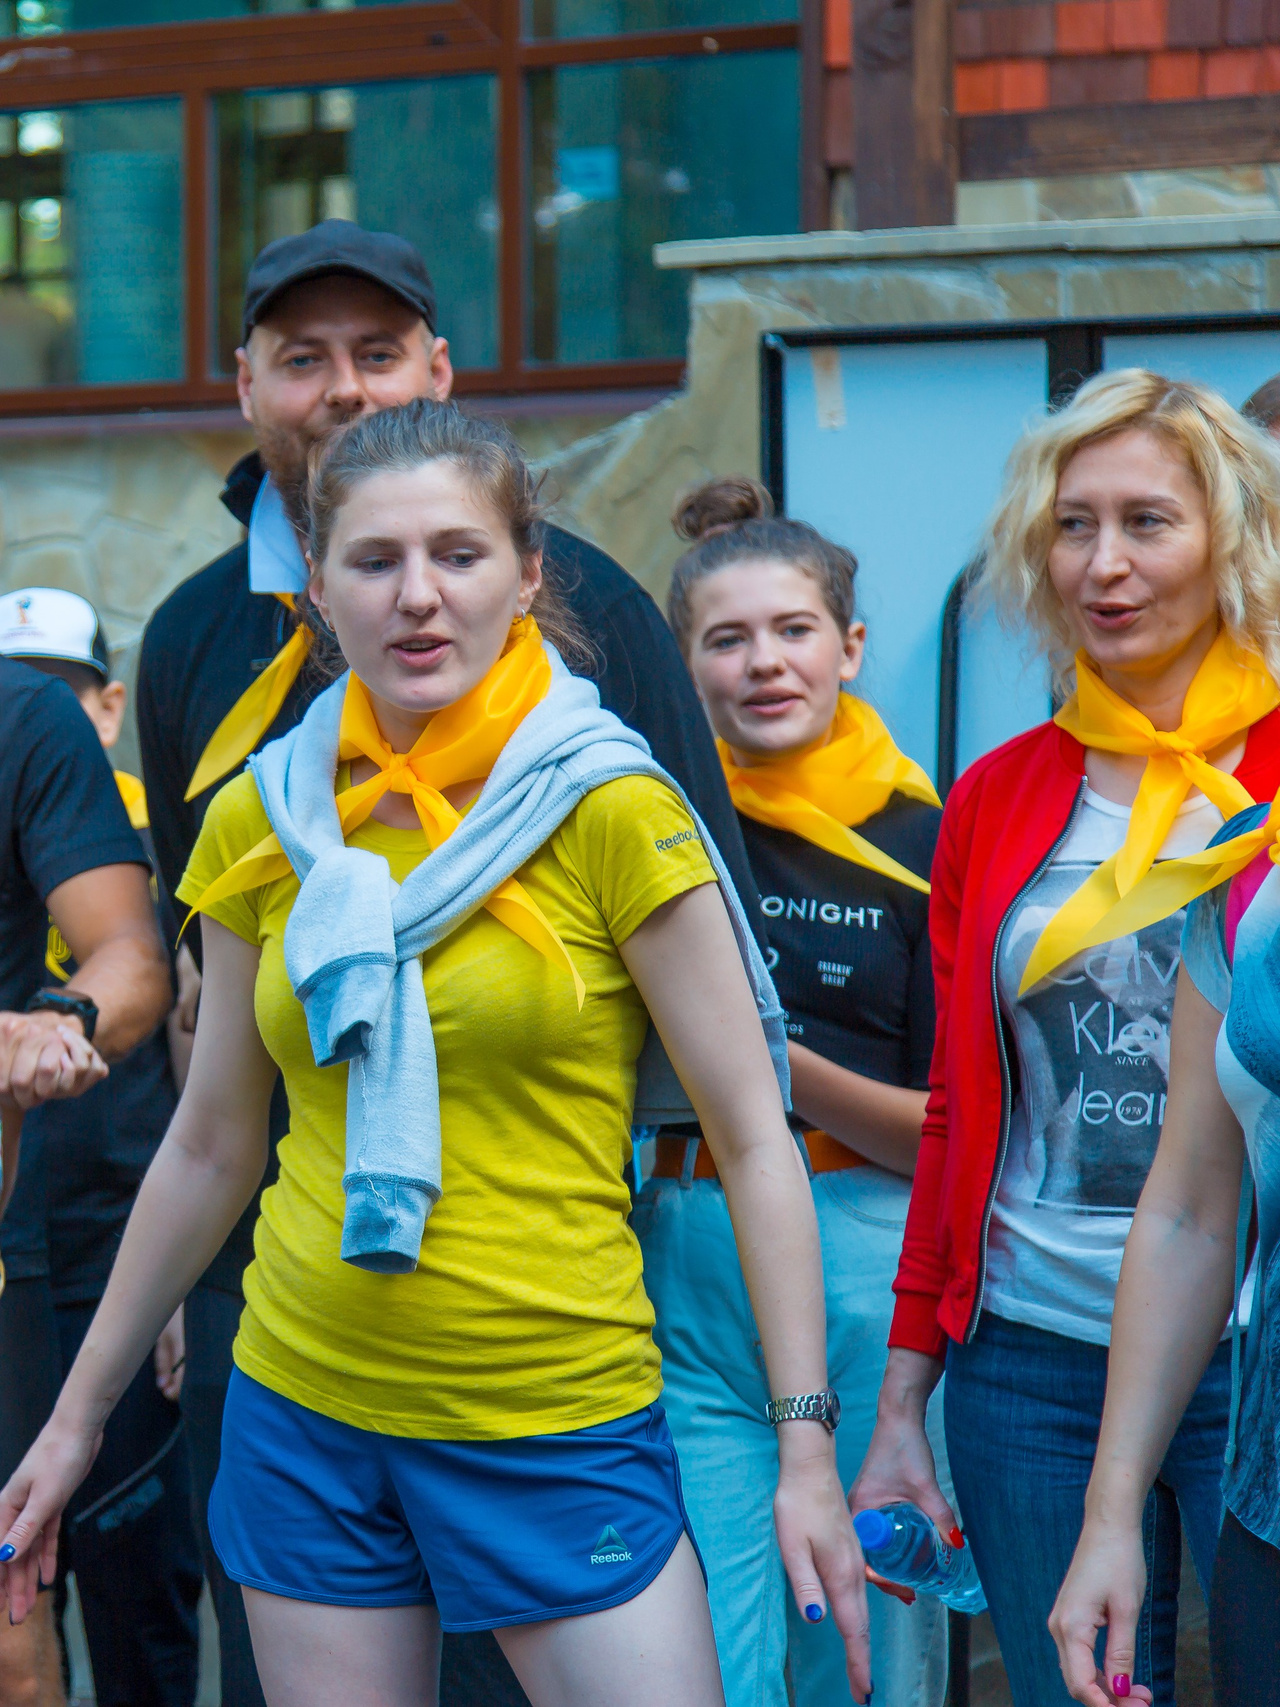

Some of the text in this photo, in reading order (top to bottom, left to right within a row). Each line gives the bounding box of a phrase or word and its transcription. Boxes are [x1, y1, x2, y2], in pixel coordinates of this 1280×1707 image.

[758, 894, 884, 930] ONIGHT
[1115, 1056, 1150, 1066] SINCE
[590, 1551, 633, 1565] Reebok
